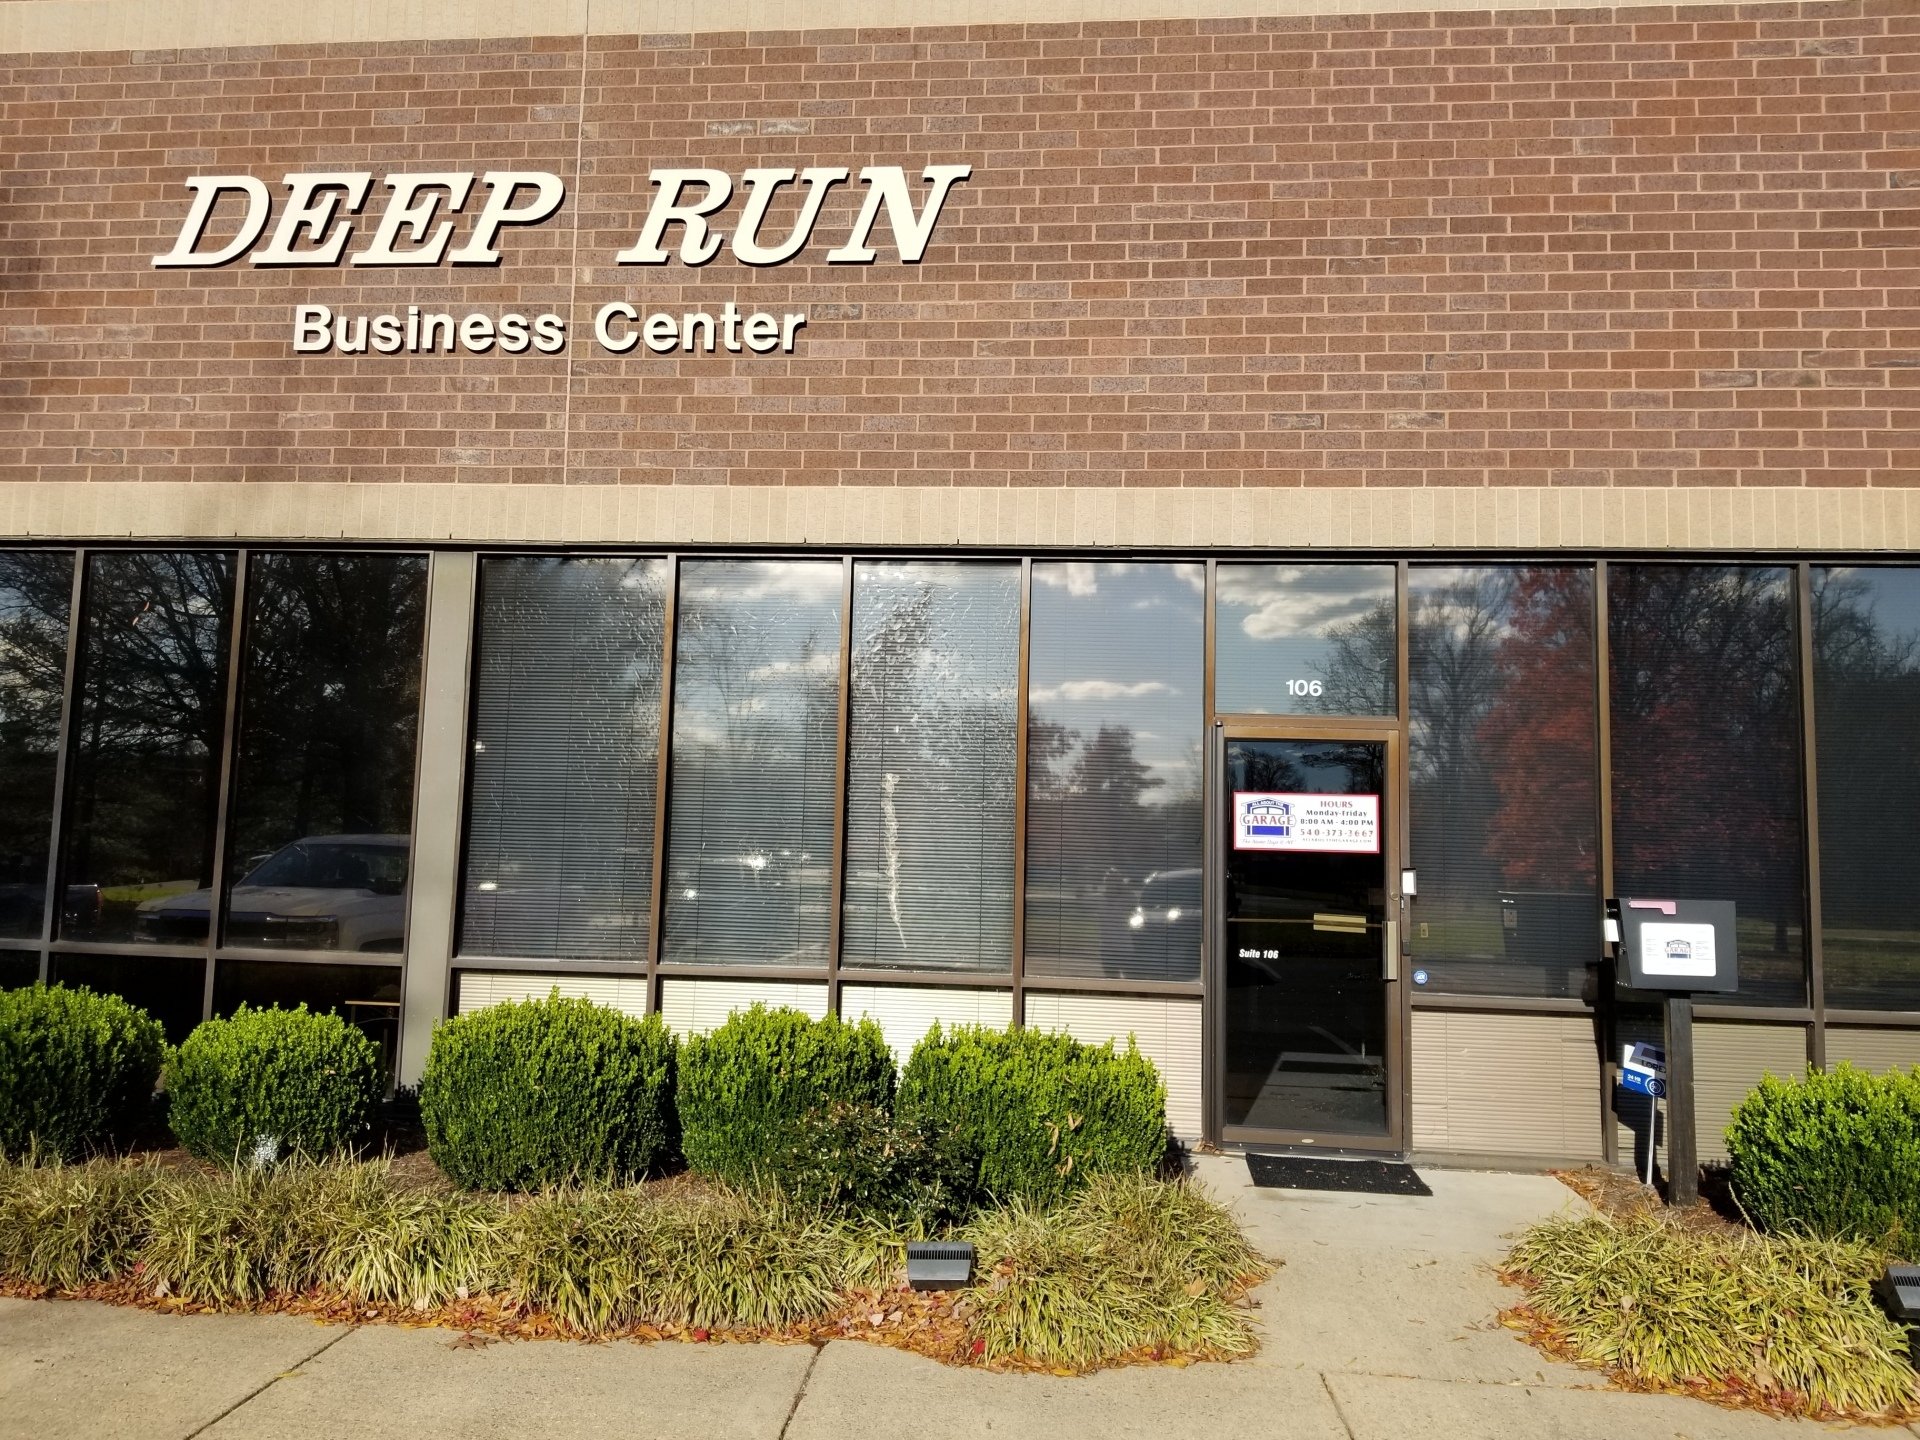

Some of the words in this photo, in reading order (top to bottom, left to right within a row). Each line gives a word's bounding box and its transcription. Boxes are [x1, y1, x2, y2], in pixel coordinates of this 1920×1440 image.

[151, 171, 565, 267] DEEP
[615, 164, 972, 265] RUN
[293, 304, 565, 352] Business
[594, 301, 806, 352] Center
[1286, 679, 1323, 697] 106
[1320, 800, 1353, 808] HOURS
[1242, 815, 1294, 826] GARAGE
[1239, 948, 1261, 959] Suite
[1263, 949, 1280, 959] 106
